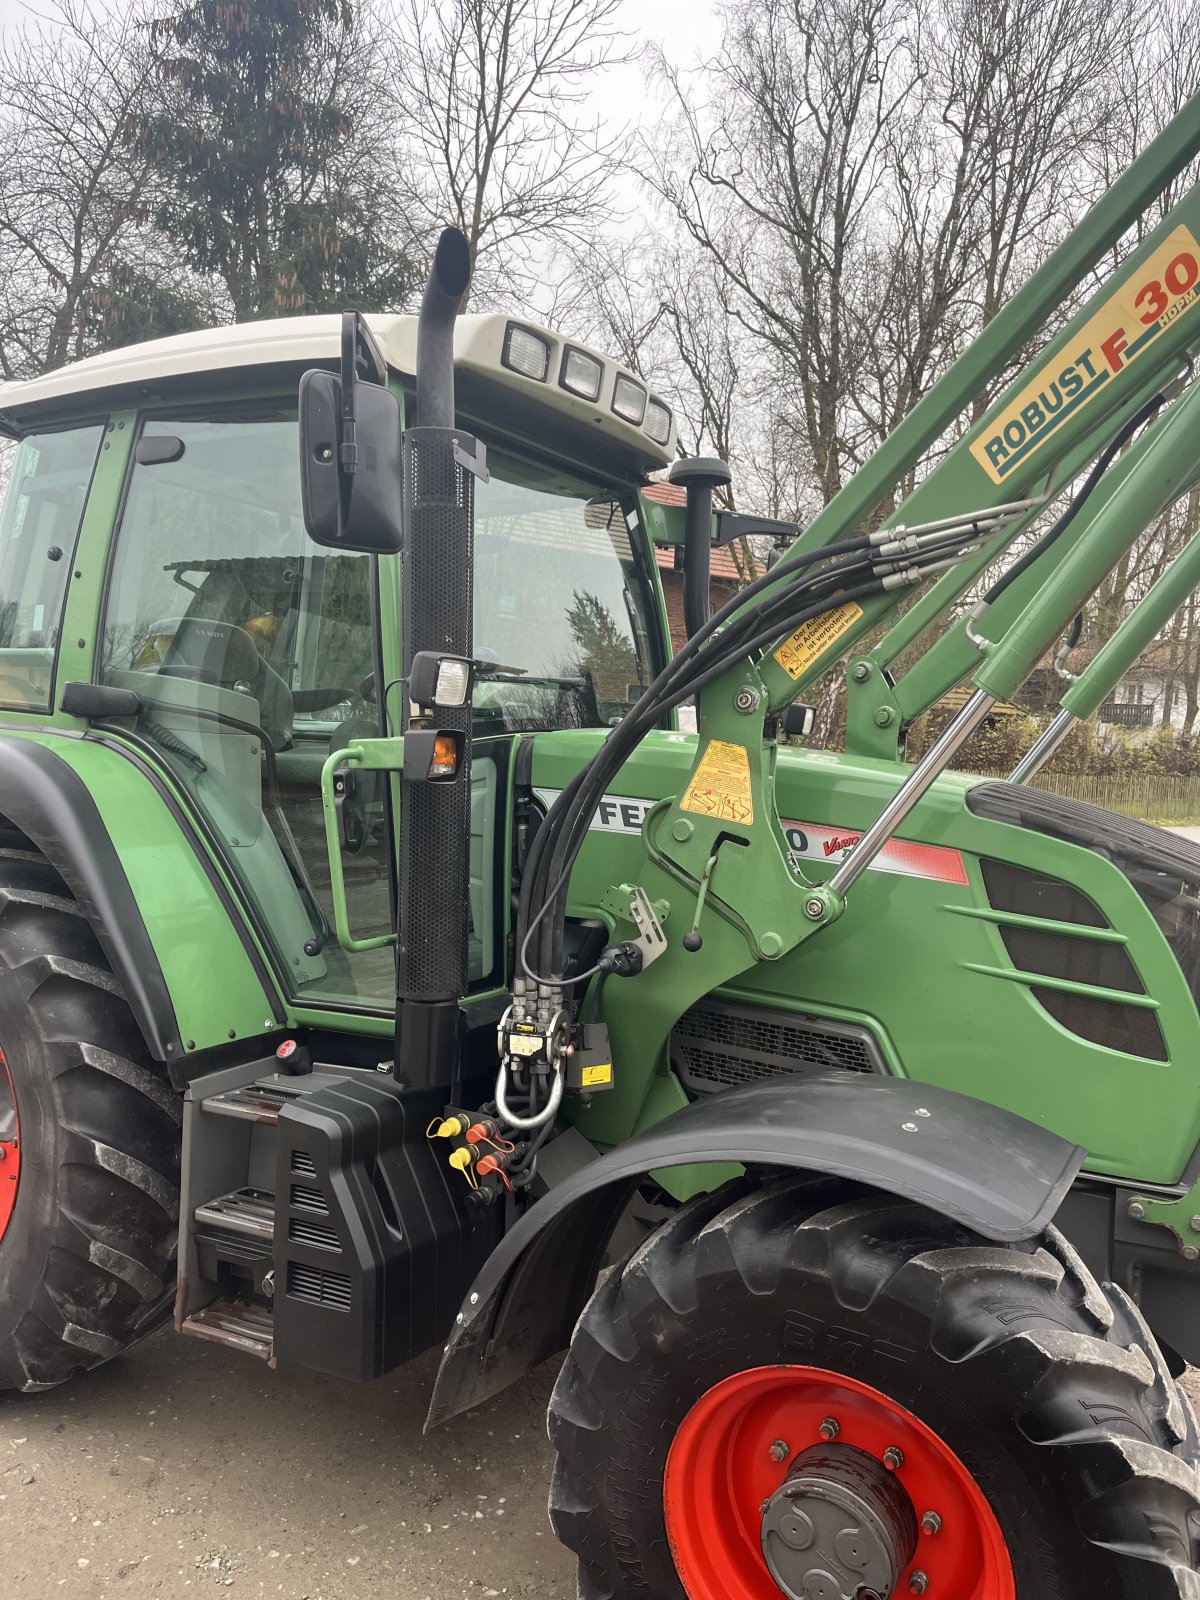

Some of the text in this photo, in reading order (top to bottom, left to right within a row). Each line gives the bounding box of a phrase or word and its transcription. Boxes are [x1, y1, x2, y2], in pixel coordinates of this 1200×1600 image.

[1158, 287, 1198, 329] HDPM
[984, 252, 1199, 469] ROBUST F 30
[793, 628, 806, 641] Der
[816, 611, 846, 641] verboten!
[794, 642, 804, 652] im
[599, 802, 650, 828] FE
